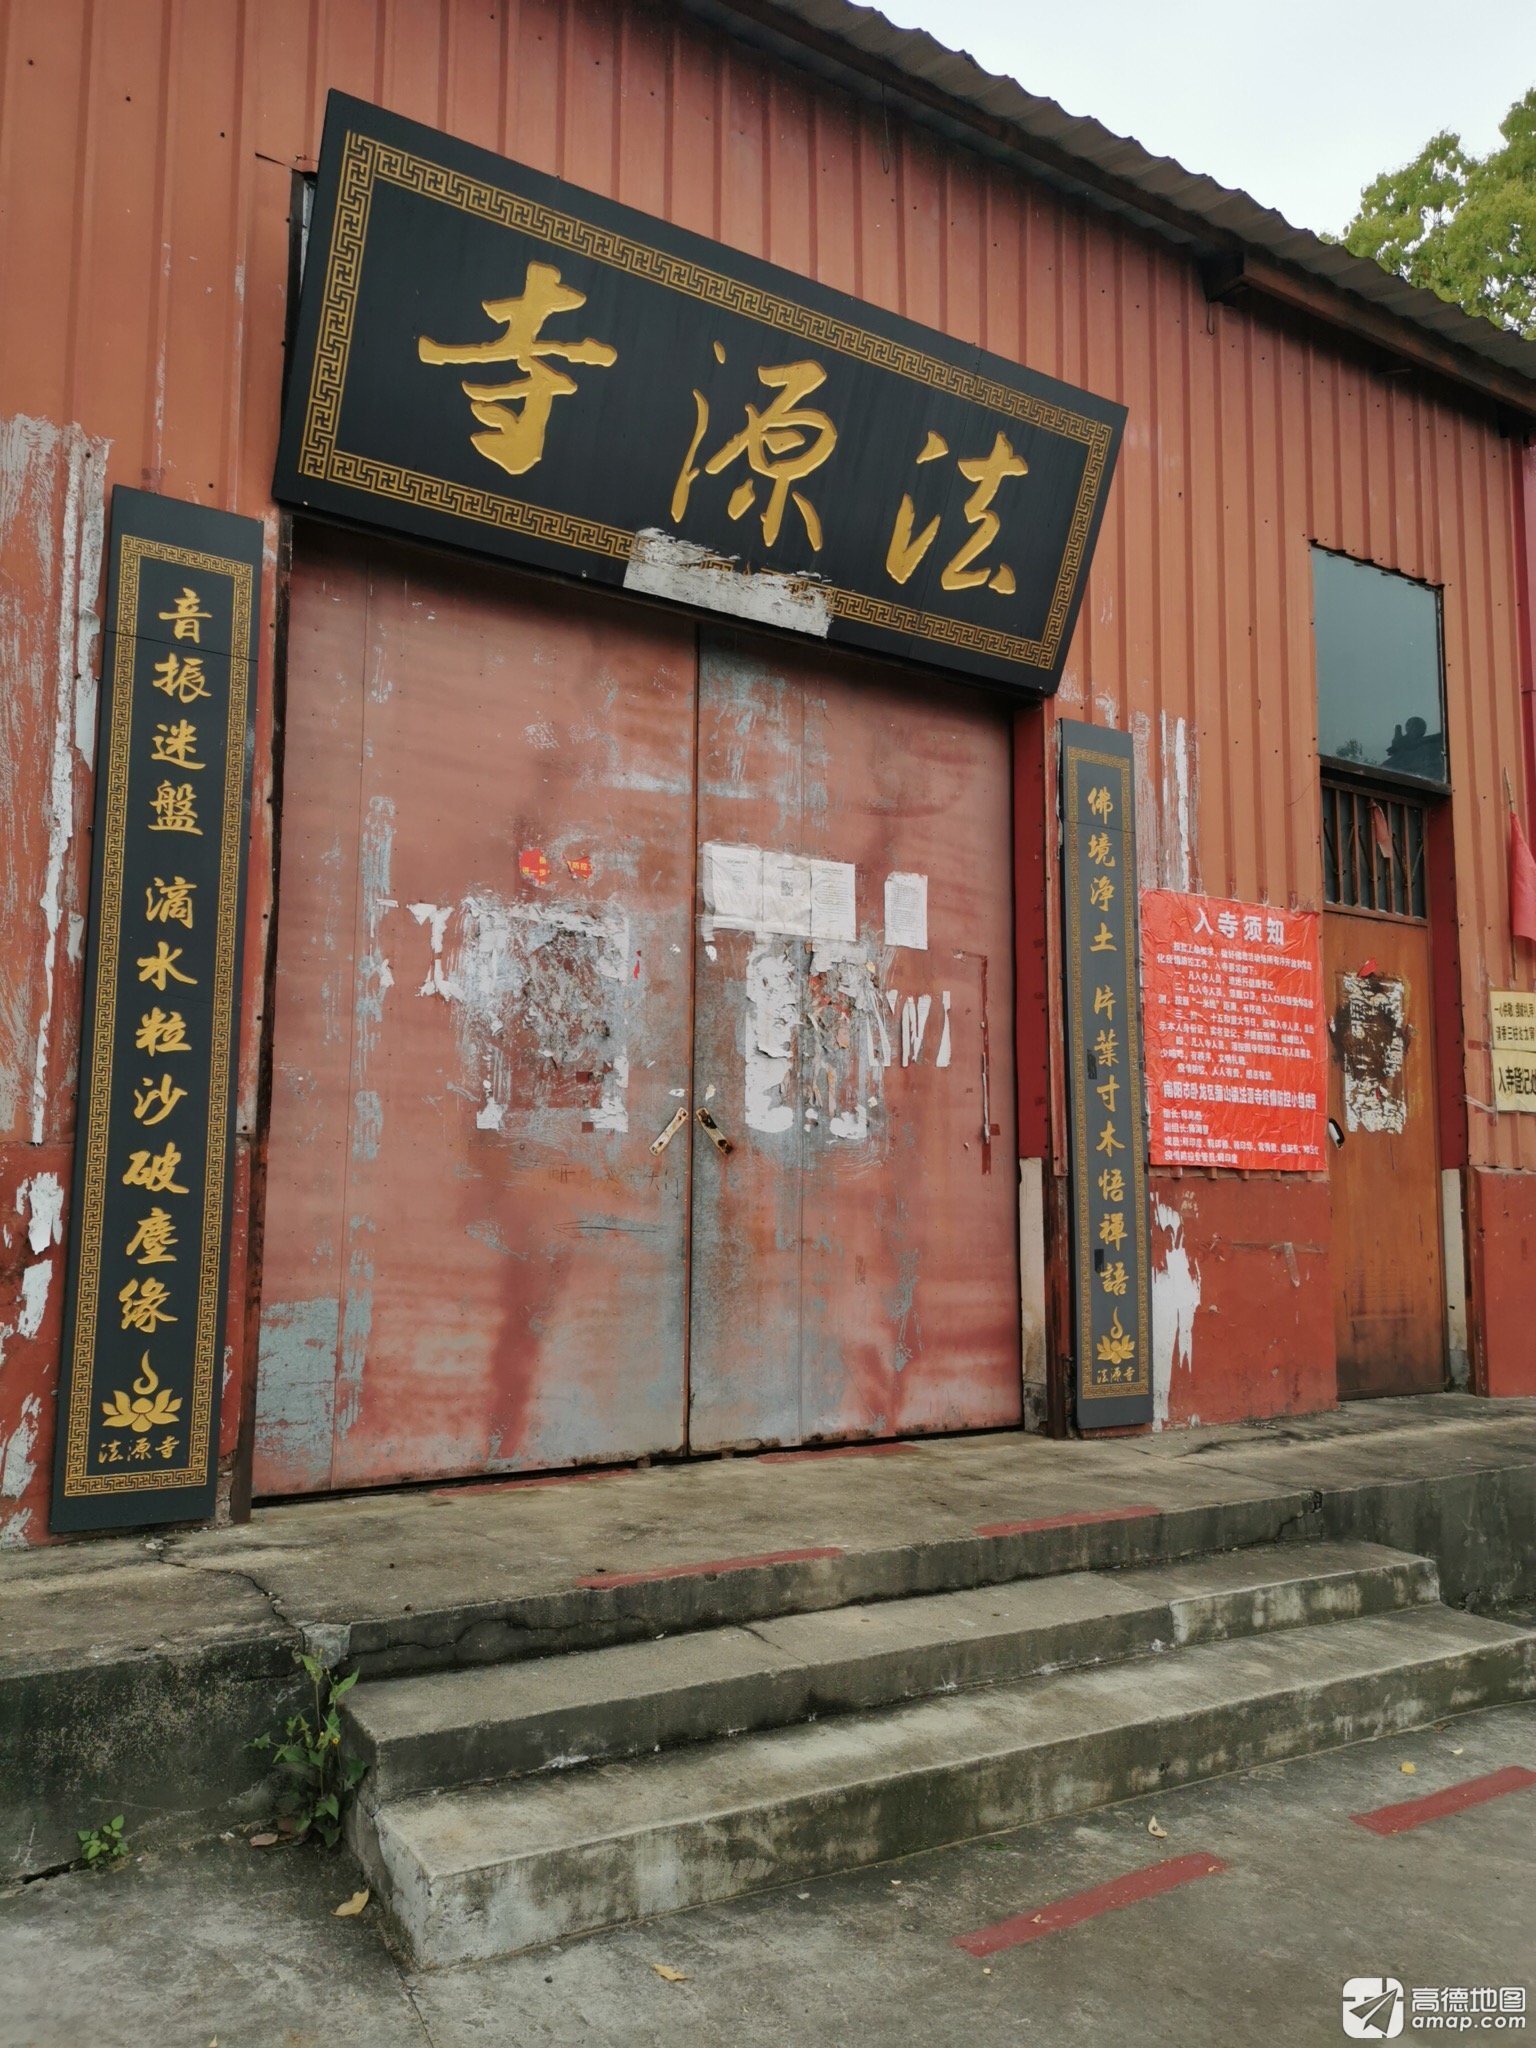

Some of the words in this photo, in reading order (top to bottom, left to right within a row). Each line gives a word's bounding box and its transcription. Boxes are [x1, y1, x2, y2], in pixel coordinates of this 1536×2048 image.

[1193, 907, 1285, 945] 入寺须知
[98, 1435, 180, 1464] 法源寺
